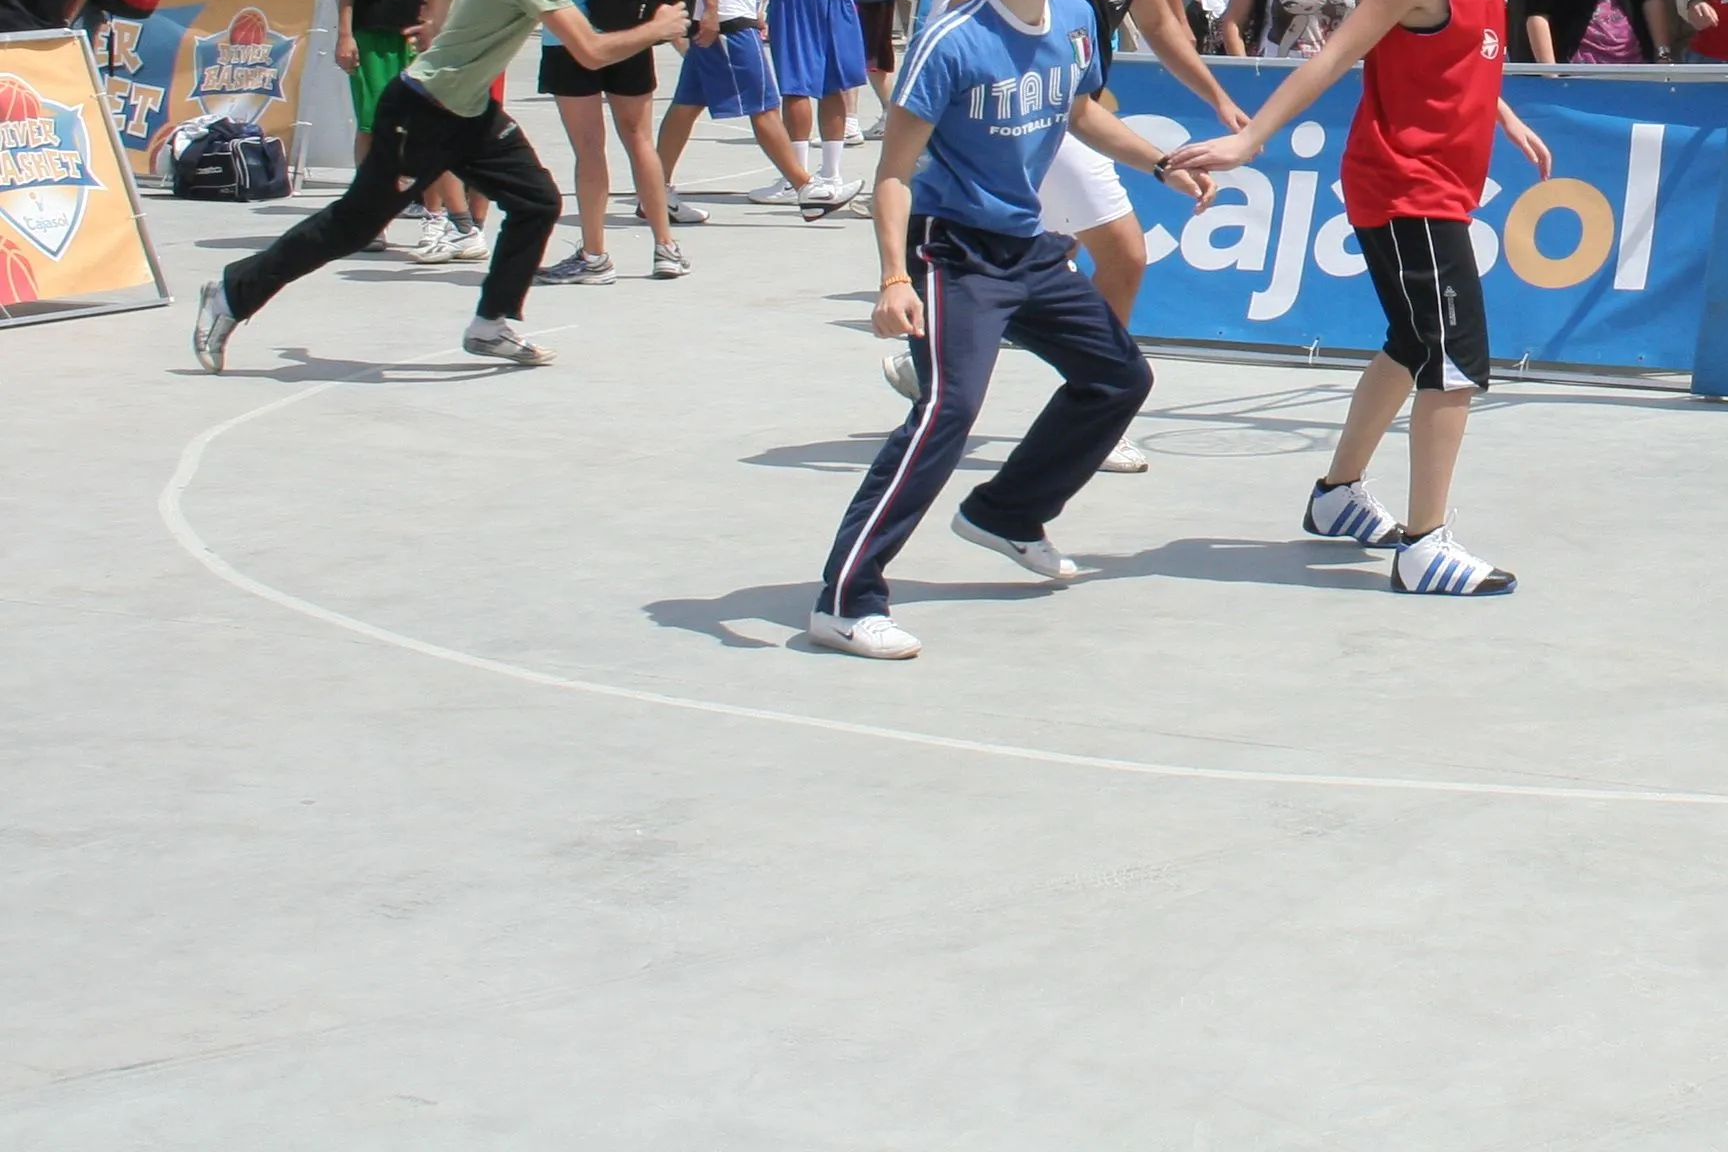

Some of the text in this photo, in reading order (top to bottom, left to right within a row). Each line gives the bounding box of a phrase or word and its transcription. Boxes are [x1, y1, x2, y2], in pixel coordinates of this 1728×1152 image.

[216, 41, 273, 66] DIVER
[200, 64, 279, 92] BASKET
[0, 117, 62, 148] IVER
[990, 118, 1052, 136] FOOTBALL
[23, 212, 70, 234] Cajasol
